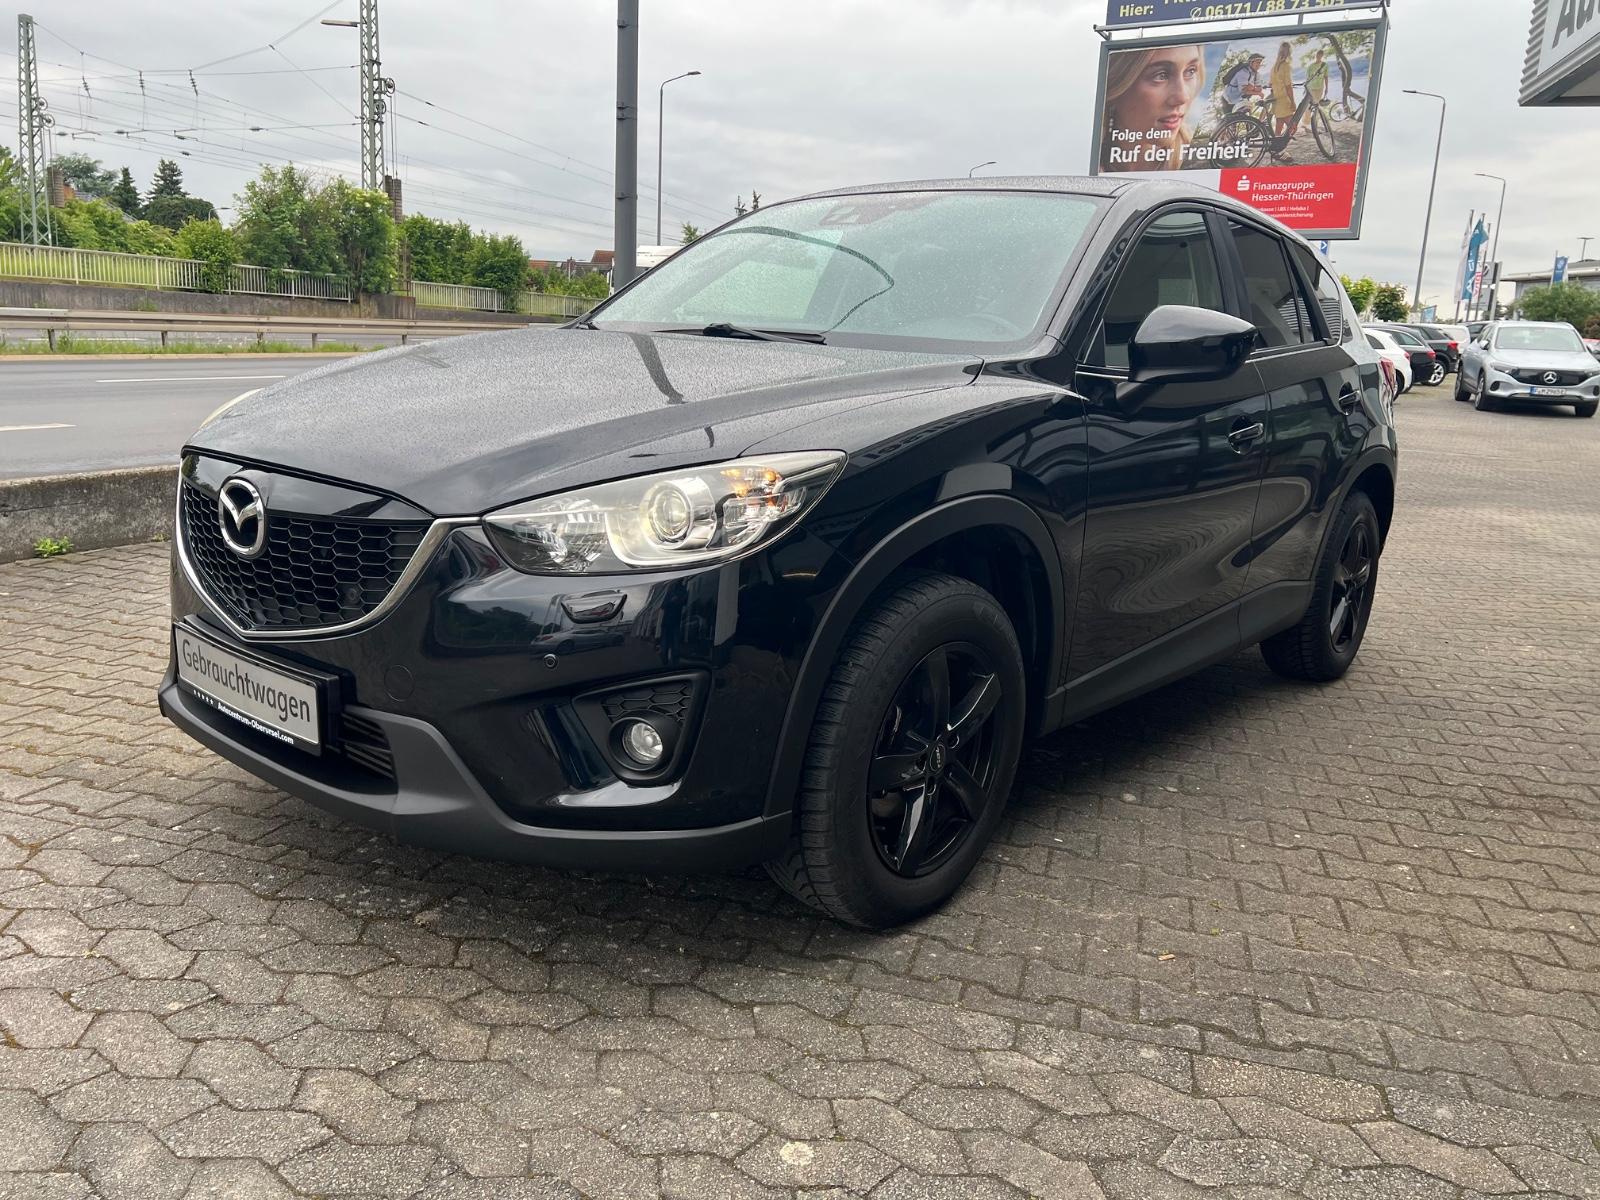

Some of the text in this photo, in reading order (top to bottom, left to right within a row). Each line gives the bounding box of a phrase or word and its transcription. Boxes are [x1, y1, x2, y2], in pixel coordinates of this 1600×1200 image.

[1119, 3, 1154, 17] Hier:
[1205, 2, 1251, 17] 06171
[1266, 0, 1285, 12] 88
[1552, 0, 1600, 49] Au
[1111, 128, 1172, 142] Folge dem
[1110, 141, 1253, 163] Ruf der Freiheit.
[1253, 181, 1315, 191] Finanzgruppe
[1252, 191, 1334, 202] Hessen-Thüringen
[182, 638, 311, 722] Gebrauchtwagen
